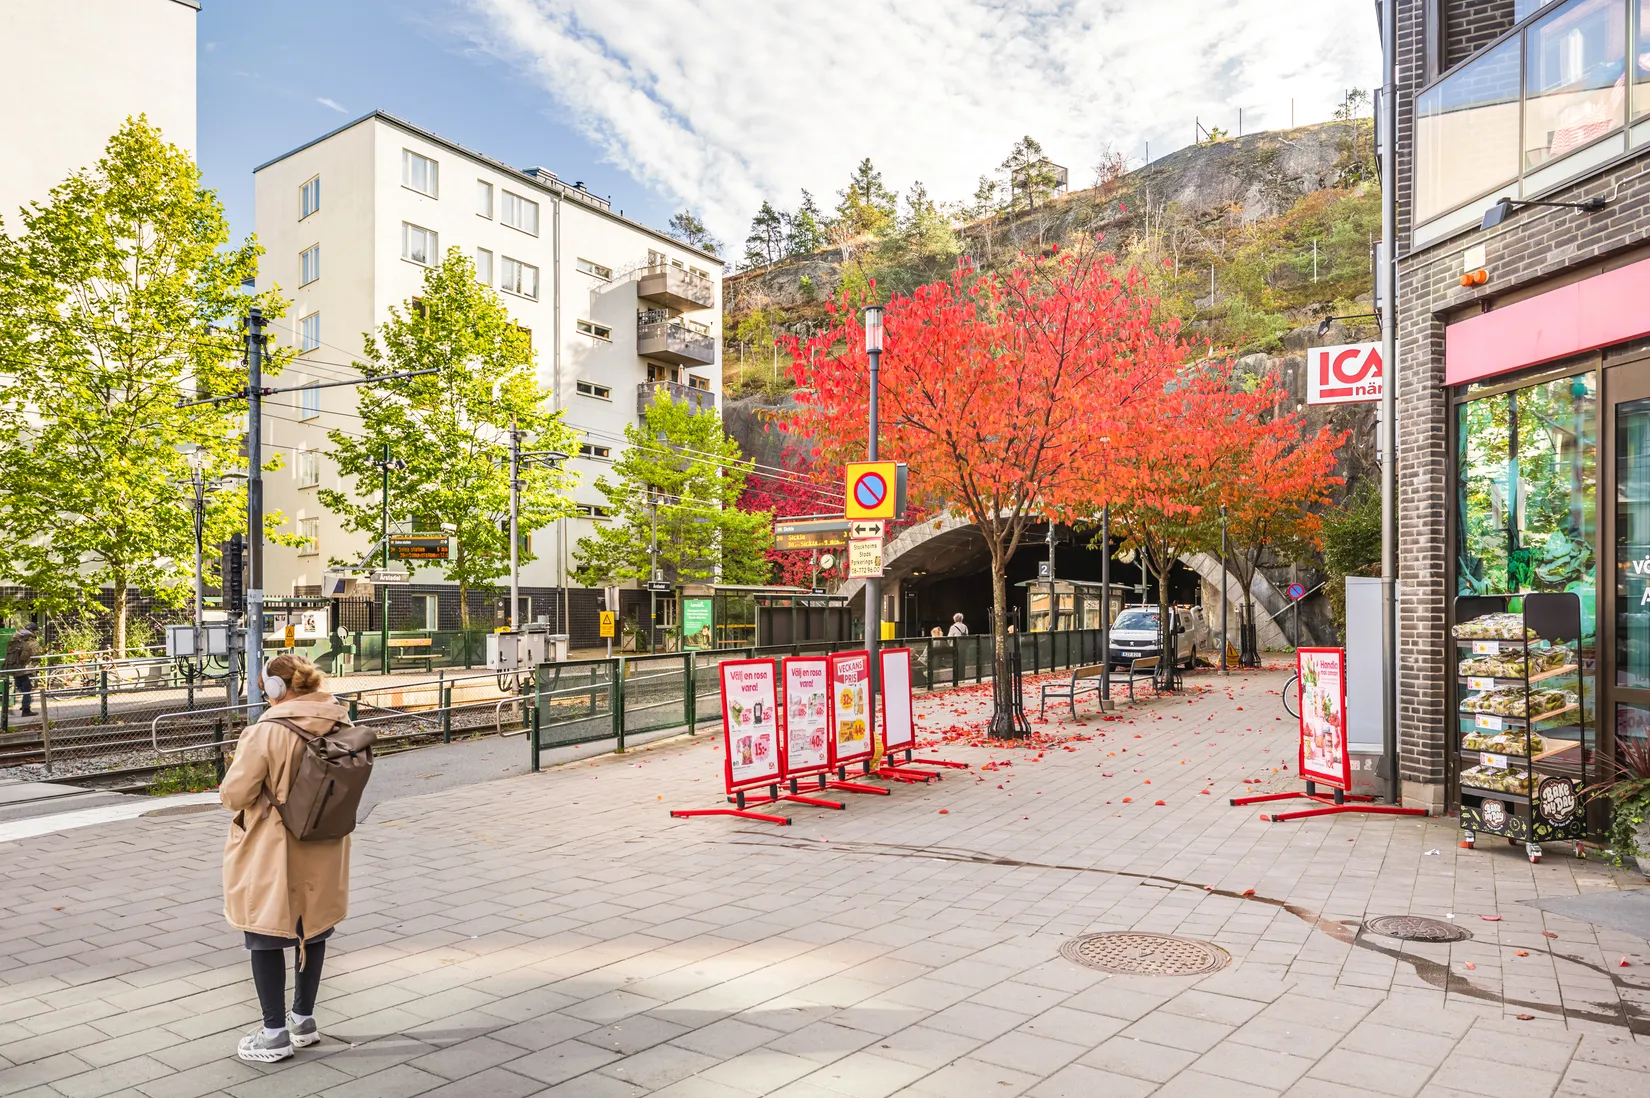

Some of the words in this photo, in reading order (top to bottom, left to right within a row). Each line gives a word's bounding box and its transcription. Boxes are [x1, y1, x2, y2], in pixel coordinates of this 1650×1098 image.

[1319, 347, 1382, 384] ICA
[1041, 565, 1048, 575] 2
[657, 572, 662, 580] 1
[838, 660, 863, 674] VECKANS
[1320, 660, 1338, 669] Handla
[730, 671, 743, 682] Välj
[744, 672, 753, 680] en
[754, 671, 767, 680] rosa
[791, 668, 802, 678] Välj
[844, 673, 857, 683] PRIS
[741, 683, 759, 692] vara!
[799, 679, 814, 687] vara!
